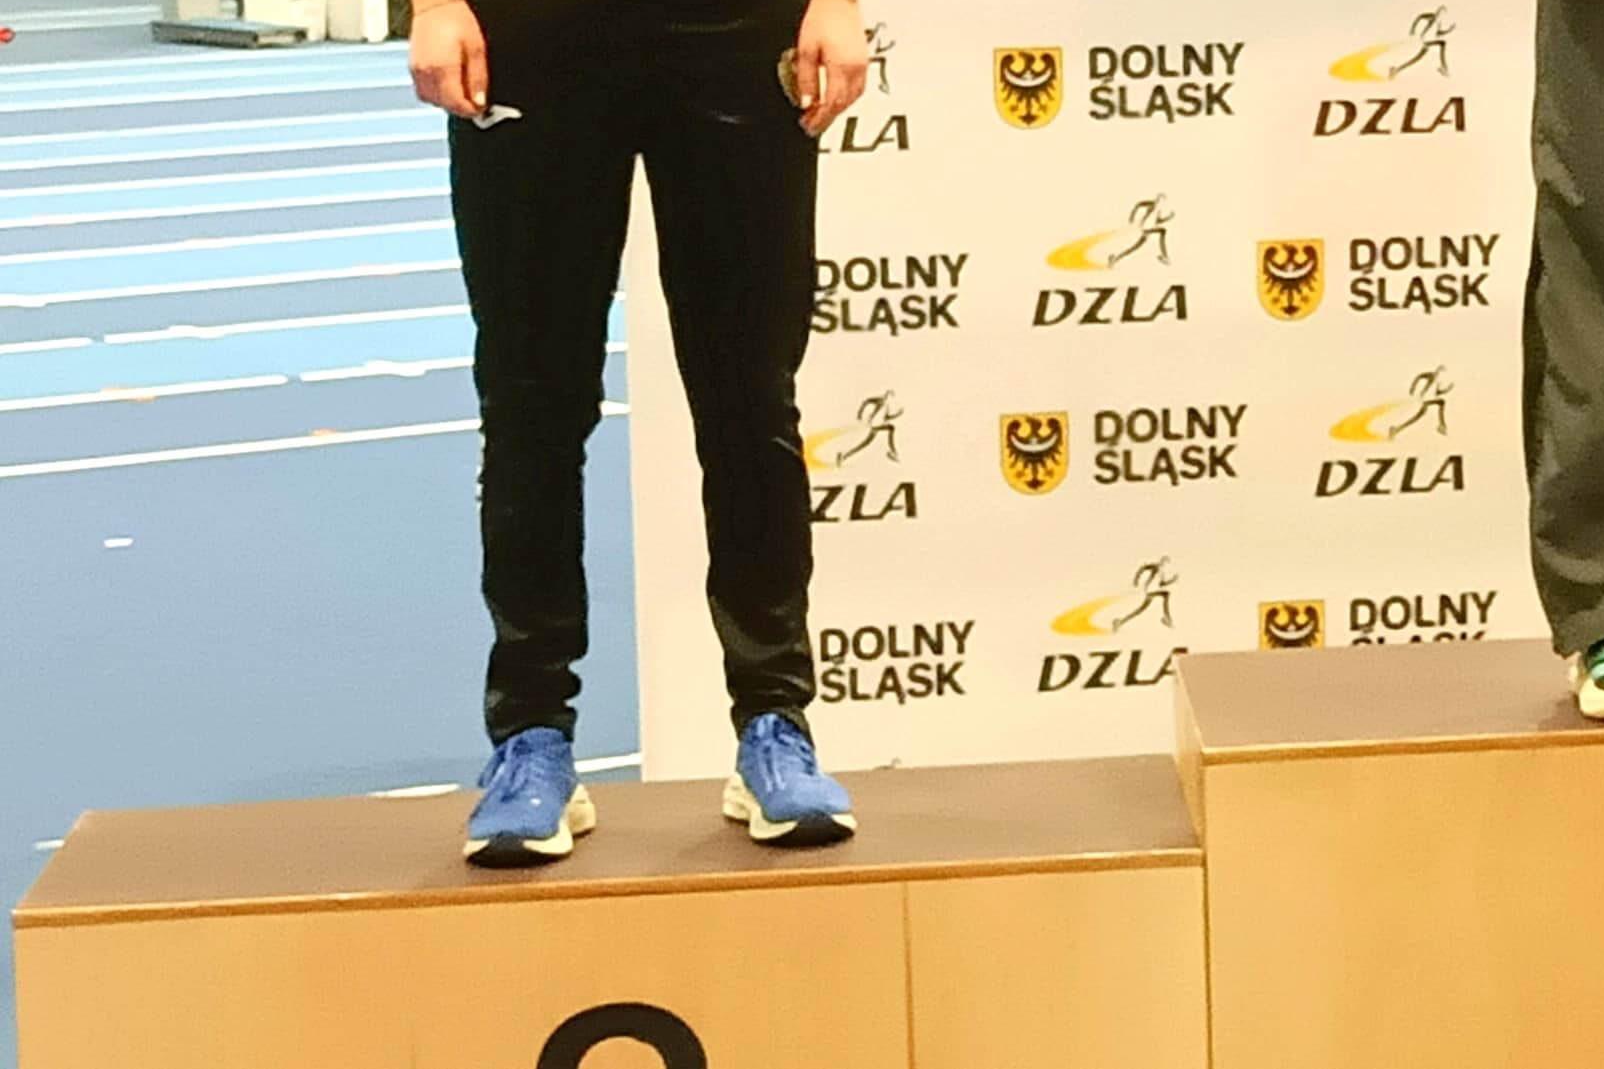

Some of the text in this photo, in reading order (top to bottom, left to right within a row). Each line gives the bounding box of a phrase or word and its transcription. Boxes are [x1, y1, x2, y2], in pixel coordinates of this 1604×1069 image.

[1089, 43, 1244, 79] DOLNY
[1090, 77, 1232, 123] ŚLĄSK
[1315, 97, 1465, 136] DZLA
[820, 115, 908, 152] LA
[1349, 234, 1498, 271] DOLNY
[815, 254, 967, 292] DOLNY
[1349, 268, 1488, 313] ŚLĄSK
[811, 288, 957, 336] ŚLĄSK
[1033, 285, 1187, 326] DZLA
[1094, 405, 1247, 443] DOLNY
[1094, 441, 1236, 486] ŚLĄSK
[1316, 455, 1464, 497] DZLA
[810, 482, 916, 522] ZLA
[1350, 591, 1496, 631] DOLNY
[820, 621, 974, 661] DOLNY
[821, 659, 964, 704] ŚLĄSK
